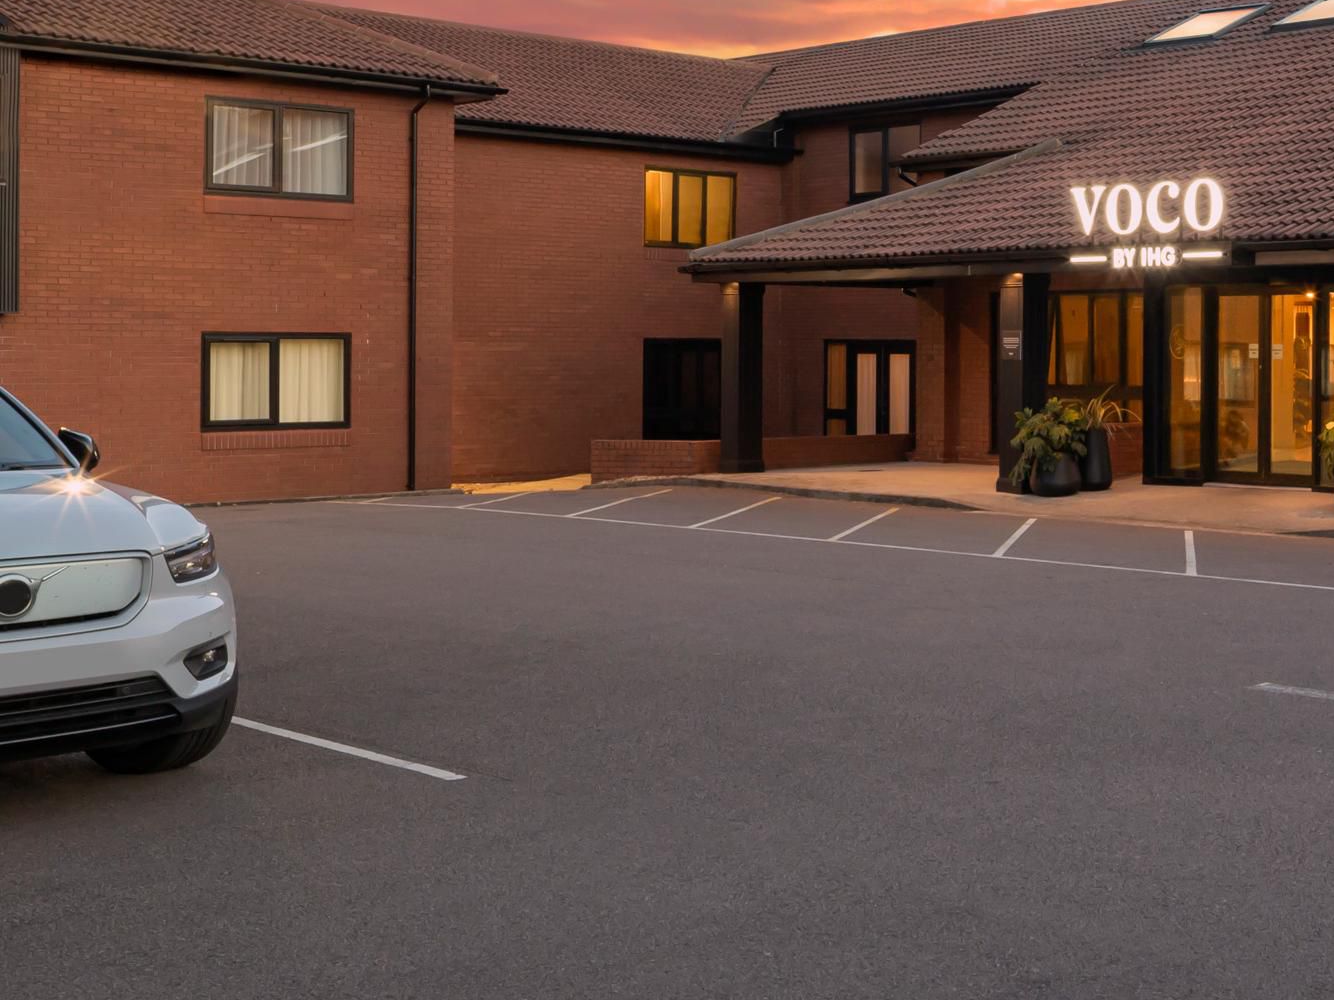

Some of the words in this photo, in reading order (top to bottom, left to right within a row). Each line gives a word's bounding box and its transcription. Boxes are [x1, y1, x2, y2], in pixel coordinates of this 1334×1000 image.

[1070, 178, 1224, 236] VOCO
[1113, 247, 1136, 268] BY
[1140, 246, 1176, 267] IHG
